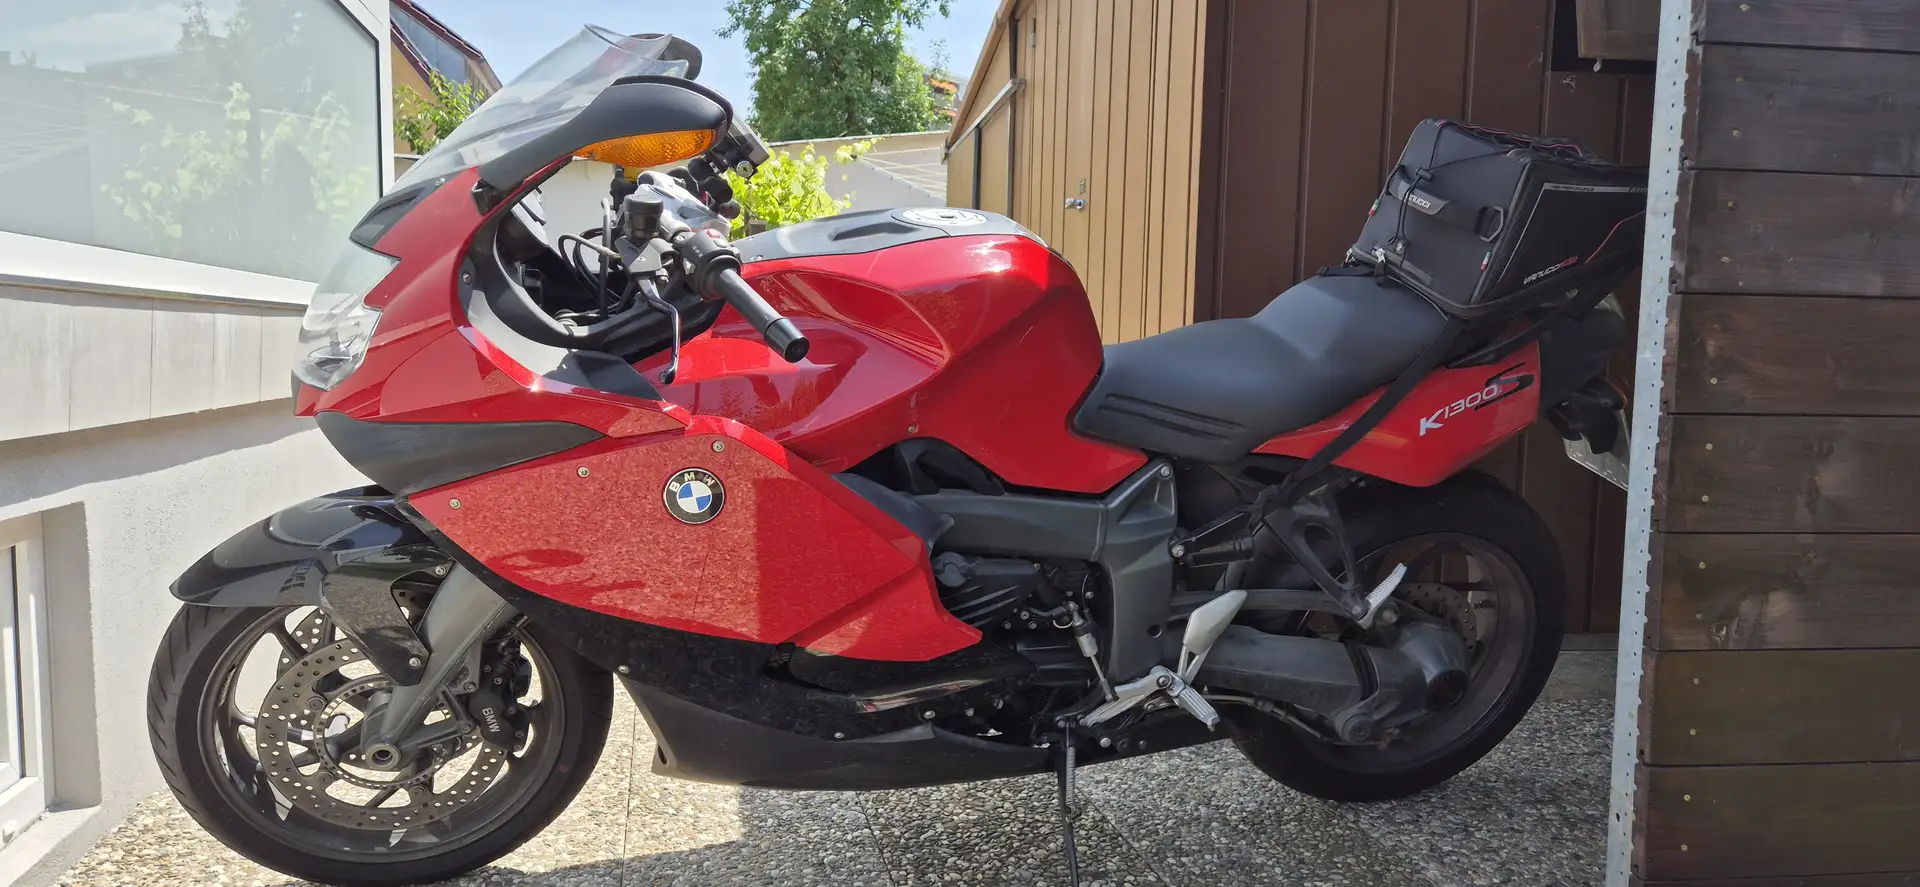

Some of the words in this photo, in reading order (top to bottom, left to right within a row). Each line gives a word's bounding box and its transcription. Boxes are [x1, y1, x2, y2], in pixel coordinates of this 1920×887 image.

[1405, 191, 1431, 208] NUCCI
[668, 472, 715, 493] BMW
[481, 707, 500, 732] BMW
